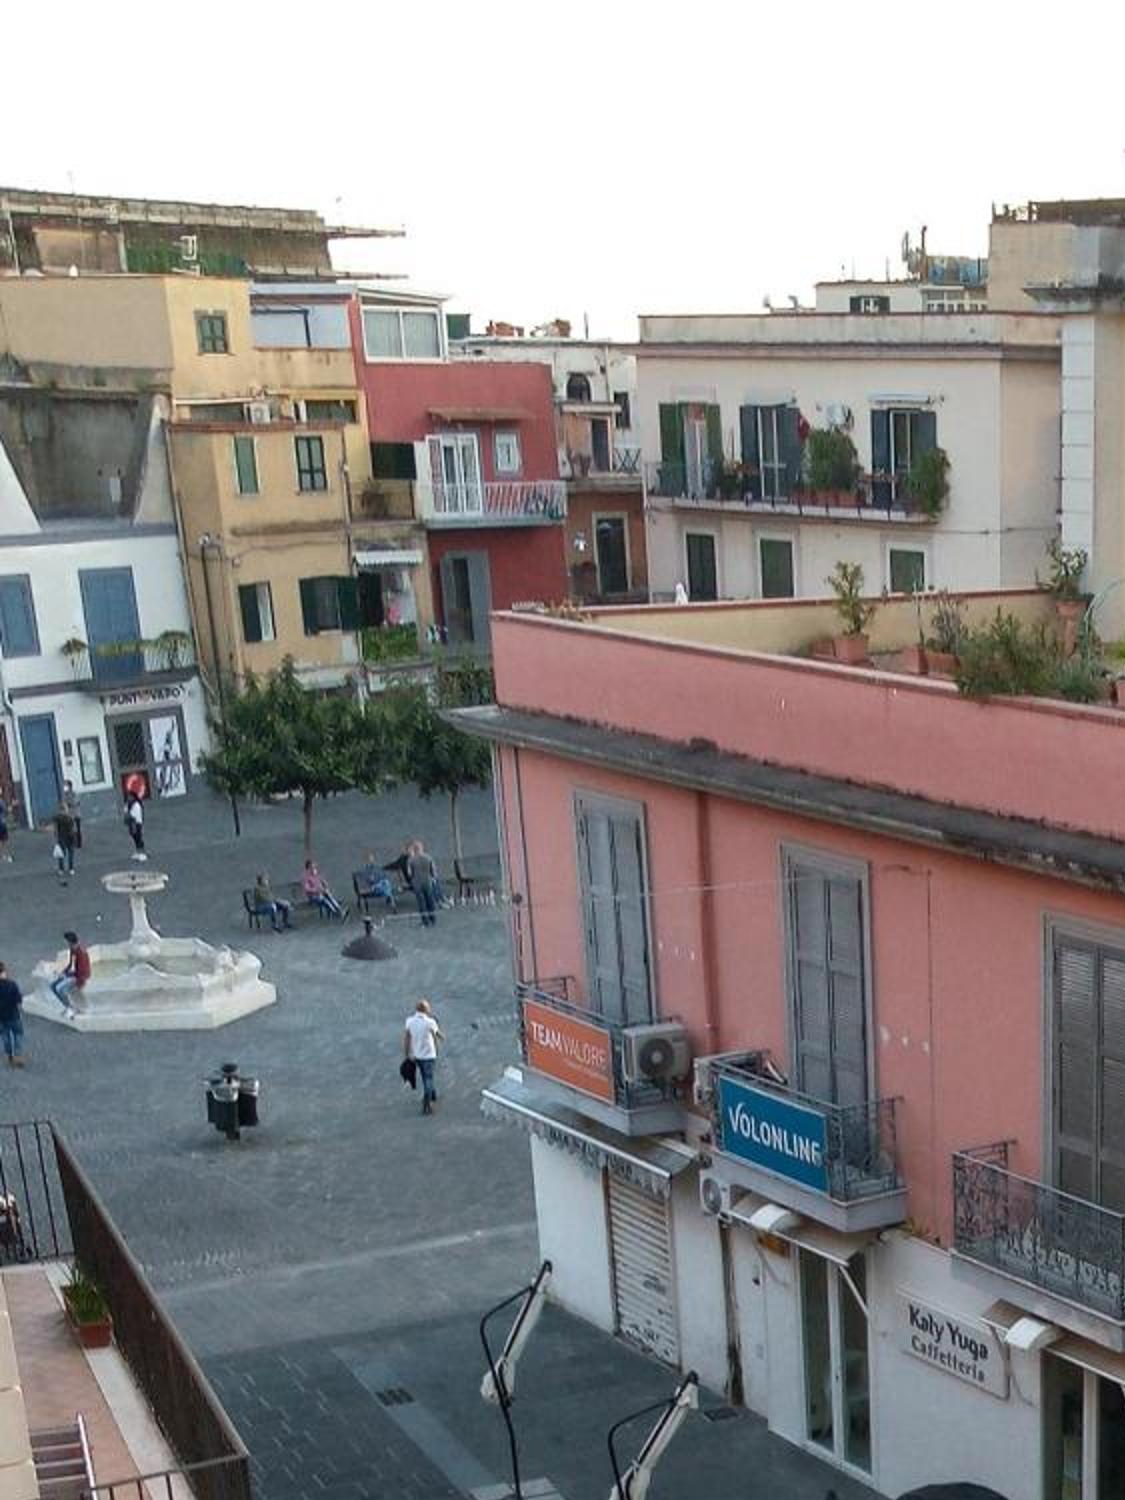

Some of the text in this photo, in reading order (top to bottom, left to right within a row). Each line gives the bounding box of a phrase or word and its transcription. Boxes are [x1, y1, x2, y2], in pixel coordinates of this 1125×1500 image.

[728, 1102, 823, 1168] VOLONLINE
[909, 1303, 989, 1362] Kaly Yuga
[911, 1335, 985, 1382] Caffetteria
